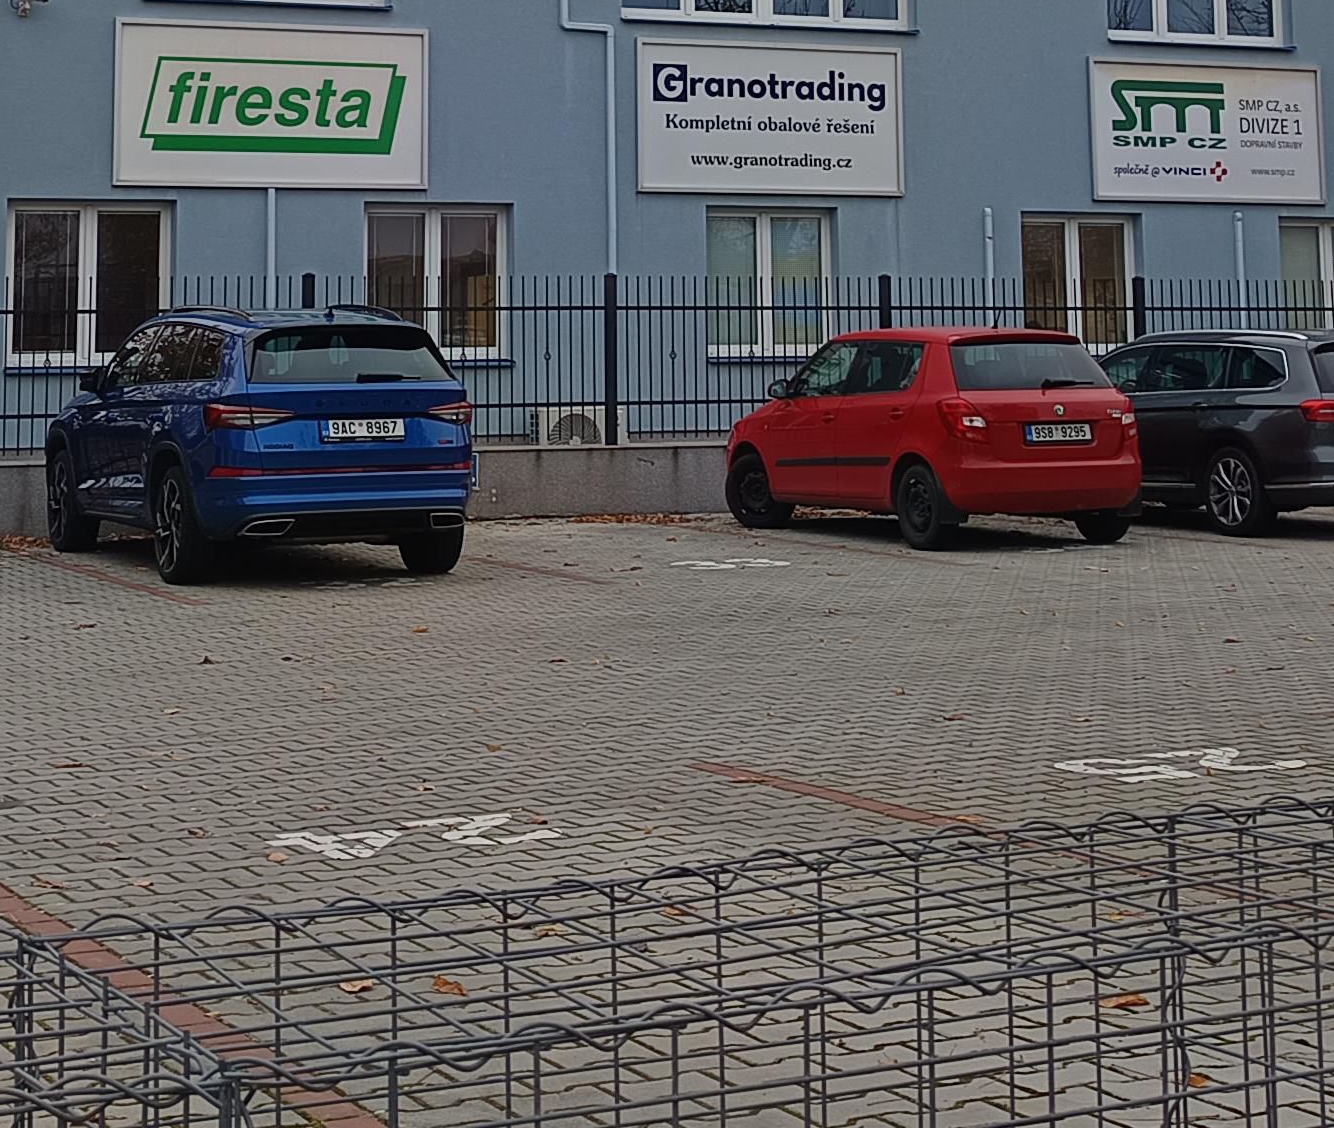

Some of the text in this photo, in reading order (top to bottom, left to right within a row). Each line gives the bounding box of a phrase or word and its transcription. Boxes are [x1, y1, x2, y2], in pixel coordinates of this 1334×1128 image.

[652, 63, 886, 112] Granotrading
[166, 71, 372, 129] firesta
[1238, 99, 1302, 113] SMP CZ, a.s.
[665, 113, 875, 134] Kompletní obalové řešení
[1240, 117, 1303, 135] DIVIZE 1
[1113, 135, 1227, 149] SMP CZ
[1241, 139, 1303, 149] DOPRAVNÍ STAVBY
[690, 153, 853, 171] www.granotrading.cz
[1113, 163, 1149, 178] společně
[1162, 167, 1206, 176] VINCI
[1251, 169, 1296, 178] www.smp.cz
[332, 421, 397, 435] 9AC 8967
[1034, 426, 1087, 439] 9S8 9295
